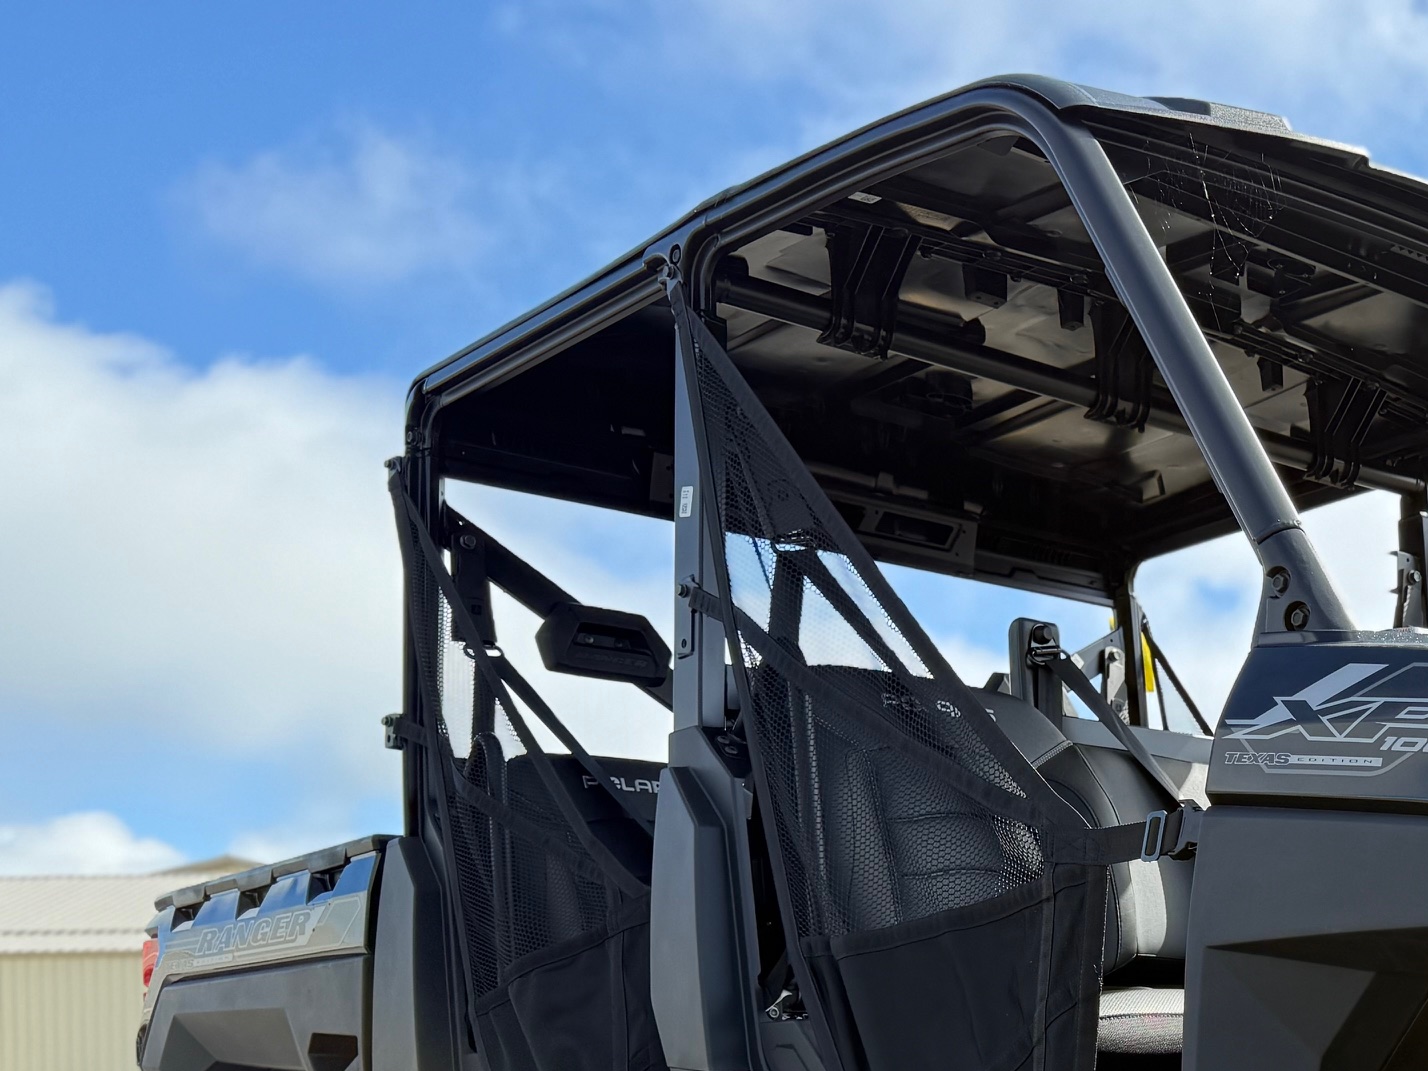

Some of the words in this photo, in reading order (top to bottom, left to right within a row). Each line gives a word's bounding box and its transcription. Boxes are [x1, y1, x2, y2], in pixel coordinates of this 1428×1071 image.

[1225, 751, 1292, 765] TEXAS
[1296, 757, 1374, 765] EDITION
[197, 911, 313, 954] RANGER
